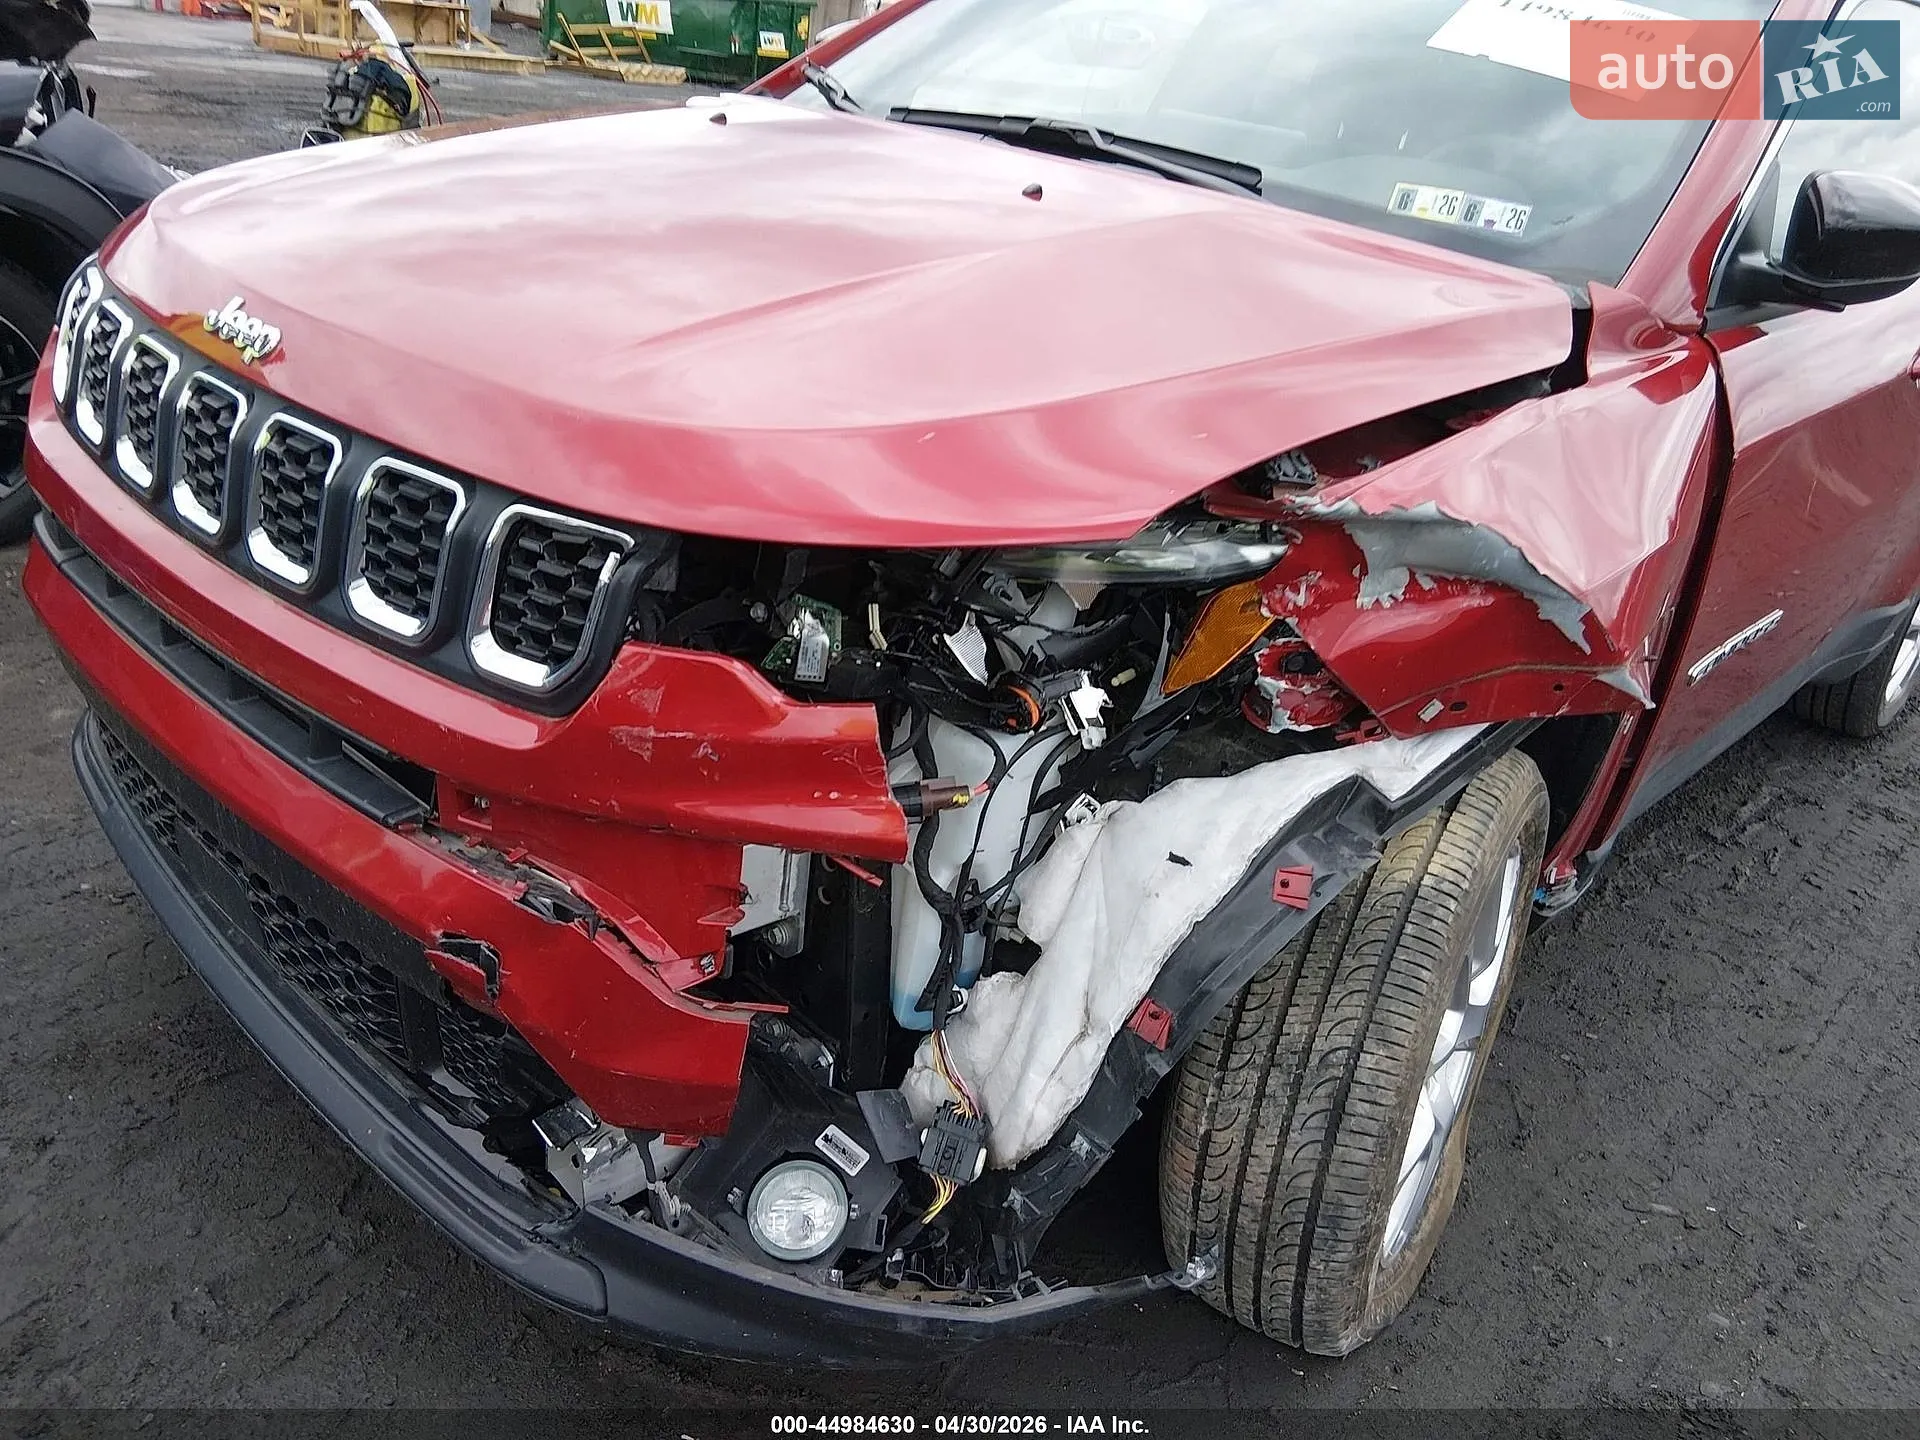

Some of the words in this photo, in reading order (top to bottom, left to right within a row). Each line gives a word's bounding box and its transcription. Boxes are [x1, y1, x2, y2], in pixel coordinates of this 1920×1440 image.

[618, 1, 660, 24] WM
[1438, 194, 1459, 217] 26
[1505, 207, 1527, 231] 26
[203, 296, 281, 365] Jeep
